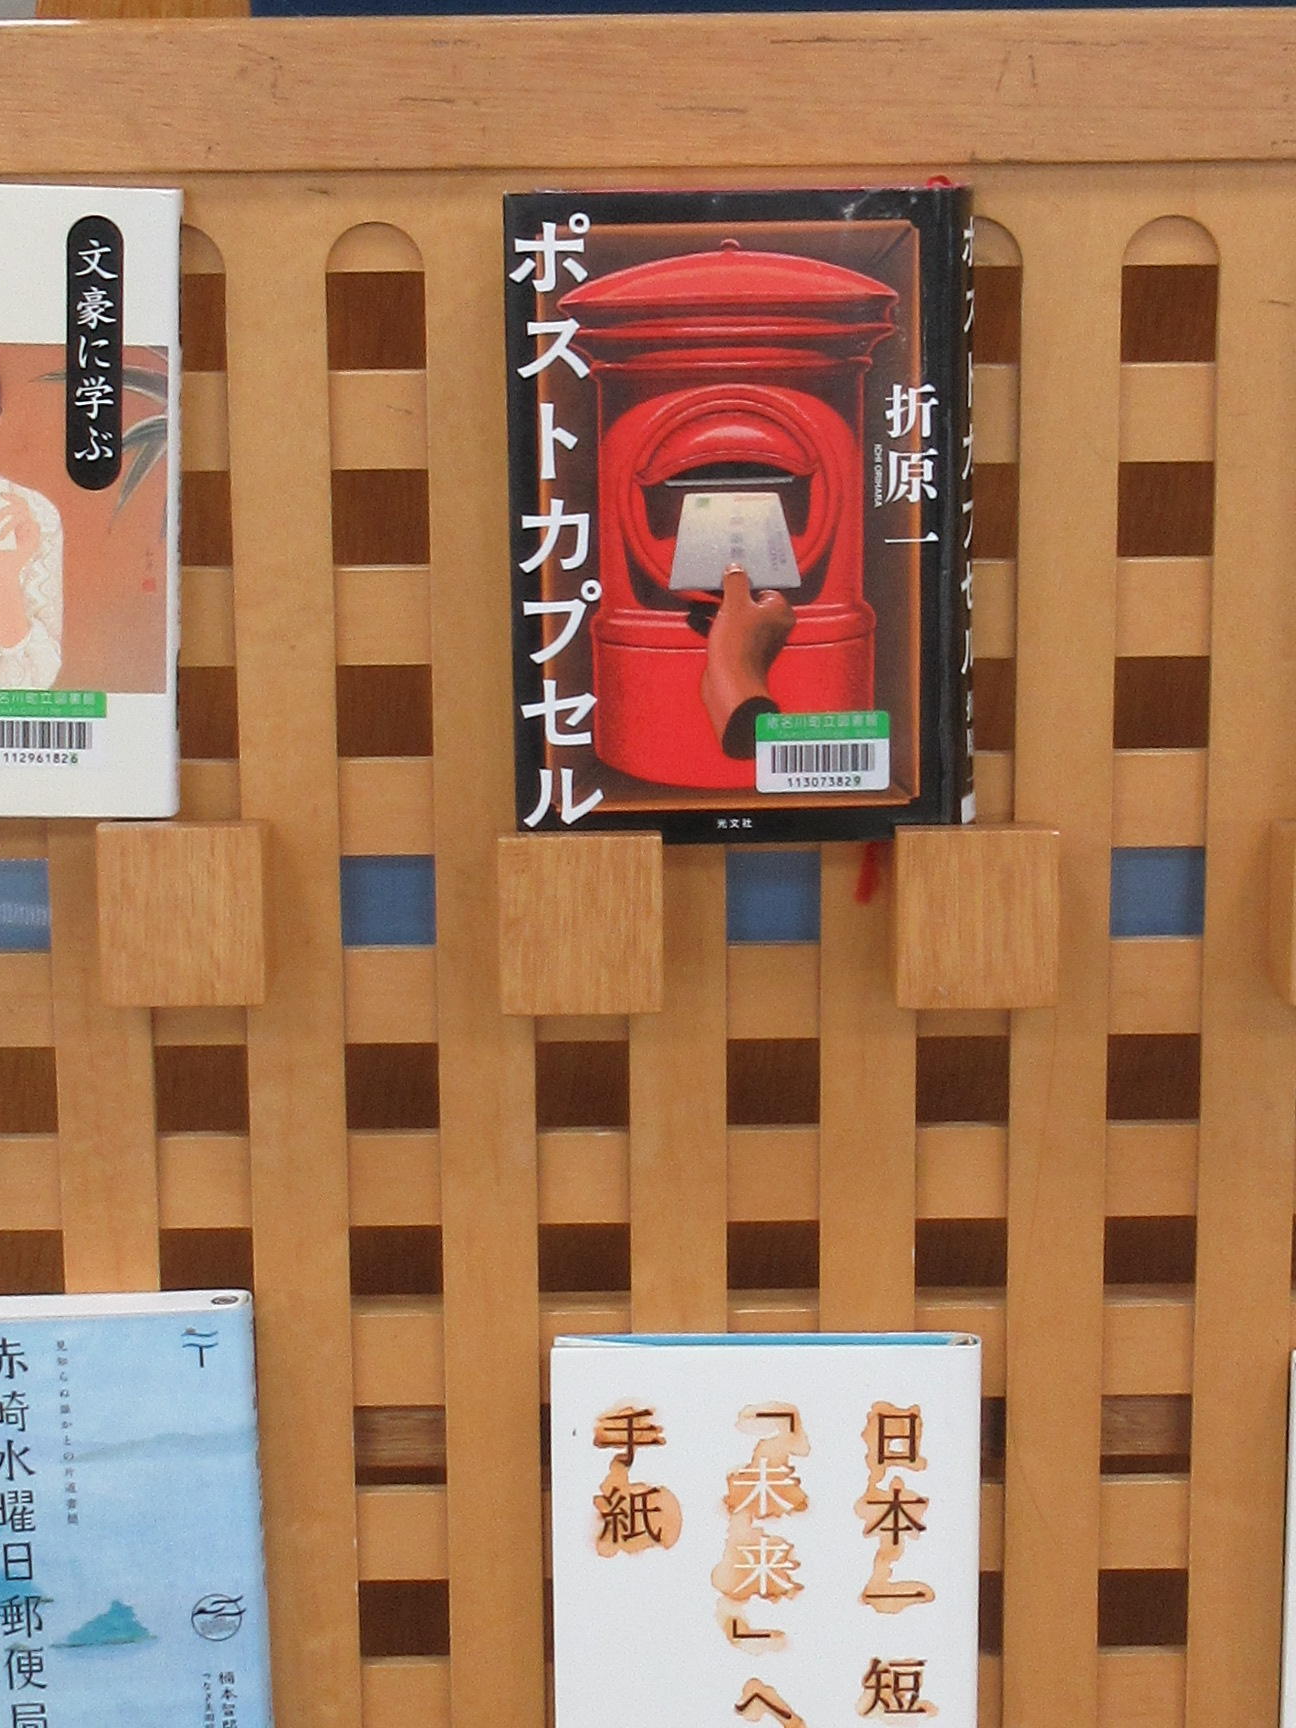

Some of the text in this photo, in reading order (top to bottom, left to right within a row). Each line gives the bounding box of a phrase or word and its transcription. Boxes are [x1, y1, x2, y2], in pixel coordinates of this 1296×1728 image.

[74, 237, 117, 462] 文豪に学ぶ
[508, 213, 604, 828] ポストカプセル
[3, 752, 79, 764] 112961826
[787, 776, 861, 788] 113073829
[716, 818, 753, 829] 光文社
[600, 1409, 664, 1544] 手紙
